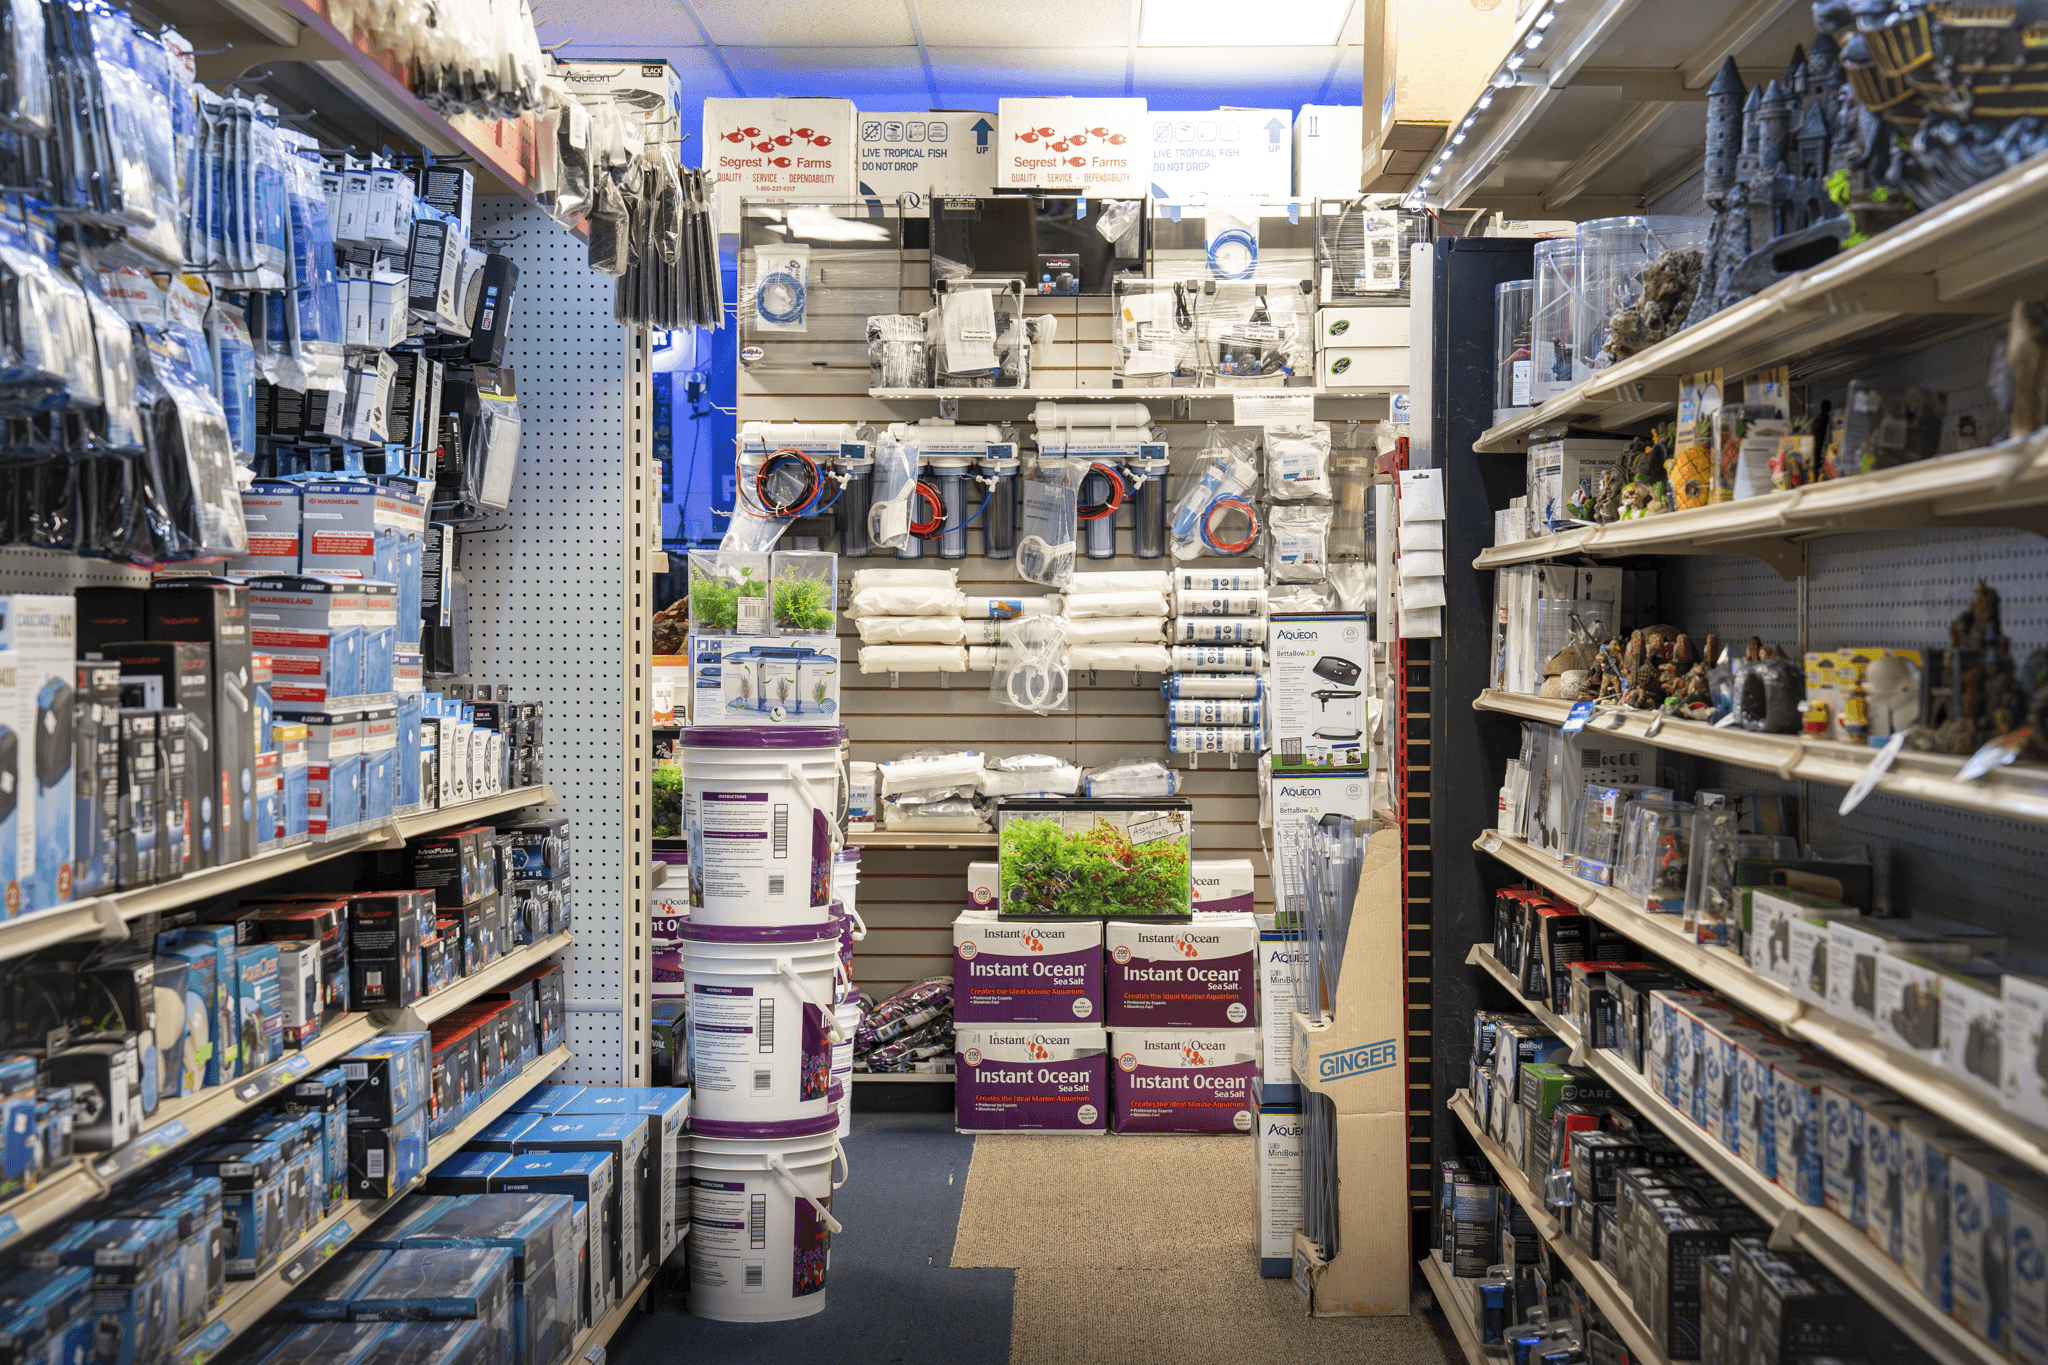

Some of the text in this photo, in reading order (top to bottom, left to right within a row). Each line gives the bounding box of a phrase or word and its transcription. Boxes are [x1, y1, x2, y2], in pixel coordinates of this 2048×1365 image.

[862, 149, 947, 158] LIVE TROPICAL FISH
[1153, 148, 1239, 158] LIVE TROPICAL FISH
[720, 157, 832, 169] Segrest Farms
[862, 162, 918, 171] DO NOT DROP
[1014, 157, 1127, 169] Segrest Farms
[1153, 162, 1210, 172] DO NOT DROP
[718, 173, 834, 184] QUALITY SERVICE DEPENDABILITY
[1011, 173, 1130, 183] QUALITY SERVICE DEPENDABILITY
[1277, 629, 1318, 641] AQUEON
[1280, 786, 1321, 797] AQUEON
[984, 929, 1065, 938] Instant Ocean
[1138, 933, 1220, 943] Instant Ocean
[970, 962, 1085, 976] Instant Ocean
[1124, 966, 1239, 981] Instant Ocean
[1223, 982, 1238, 990] Salt
[1206, 993, 1239, 1001] Aquarium
[989, 1035, 1070, 1044] Instant Ocean
[1144, 1041, 1226, 1050] Instant Ocean
[1319, 1045, 1396, 1077] GINGER
[975, 1068, 1089, 1083] Instant Ocean
[1130, 1074, 1245, 1089] Instant Ocean
[1580, 1089, 1612, 1098] CARE
